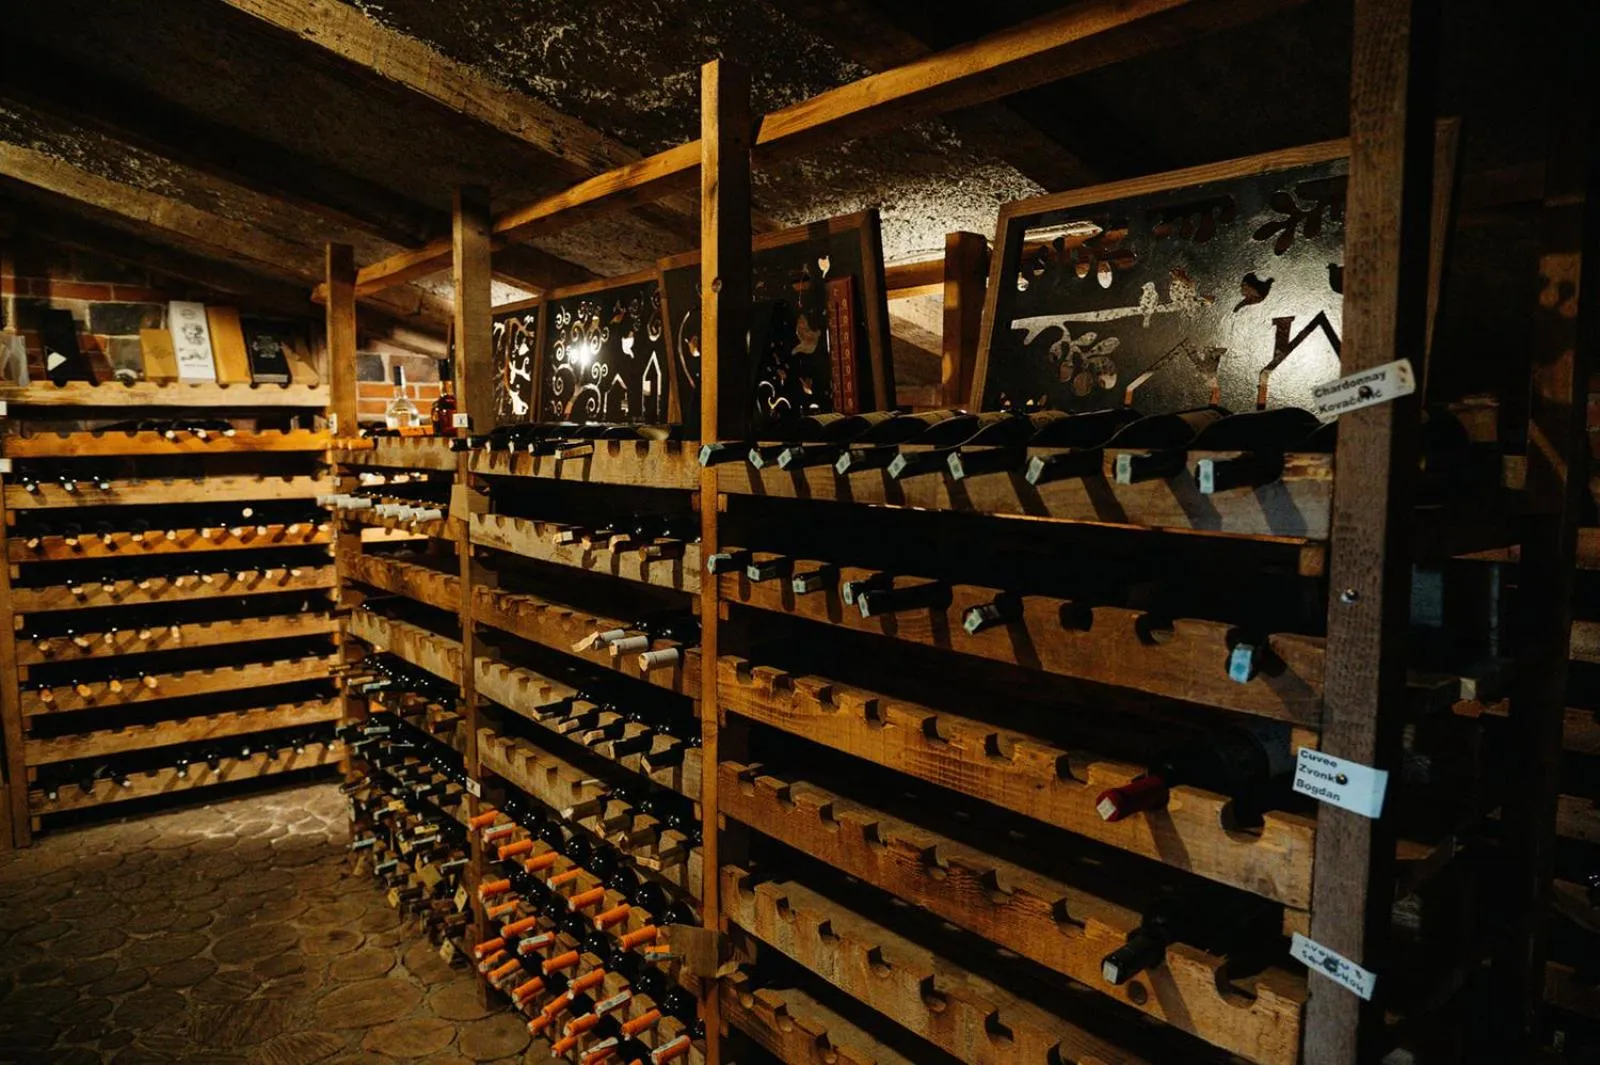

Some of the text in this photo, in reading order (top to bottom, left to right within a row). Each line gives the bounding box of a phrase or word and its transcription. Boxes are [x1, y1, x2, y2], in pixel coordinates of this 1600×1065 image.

[1313, 371, 1387, 398] Chardonnay
[1300, 749, 1338, 768] Cuvee
[1298, 763, 1342, 784] Zvonk
[1296, 778, 1341, 801] Bogdan
